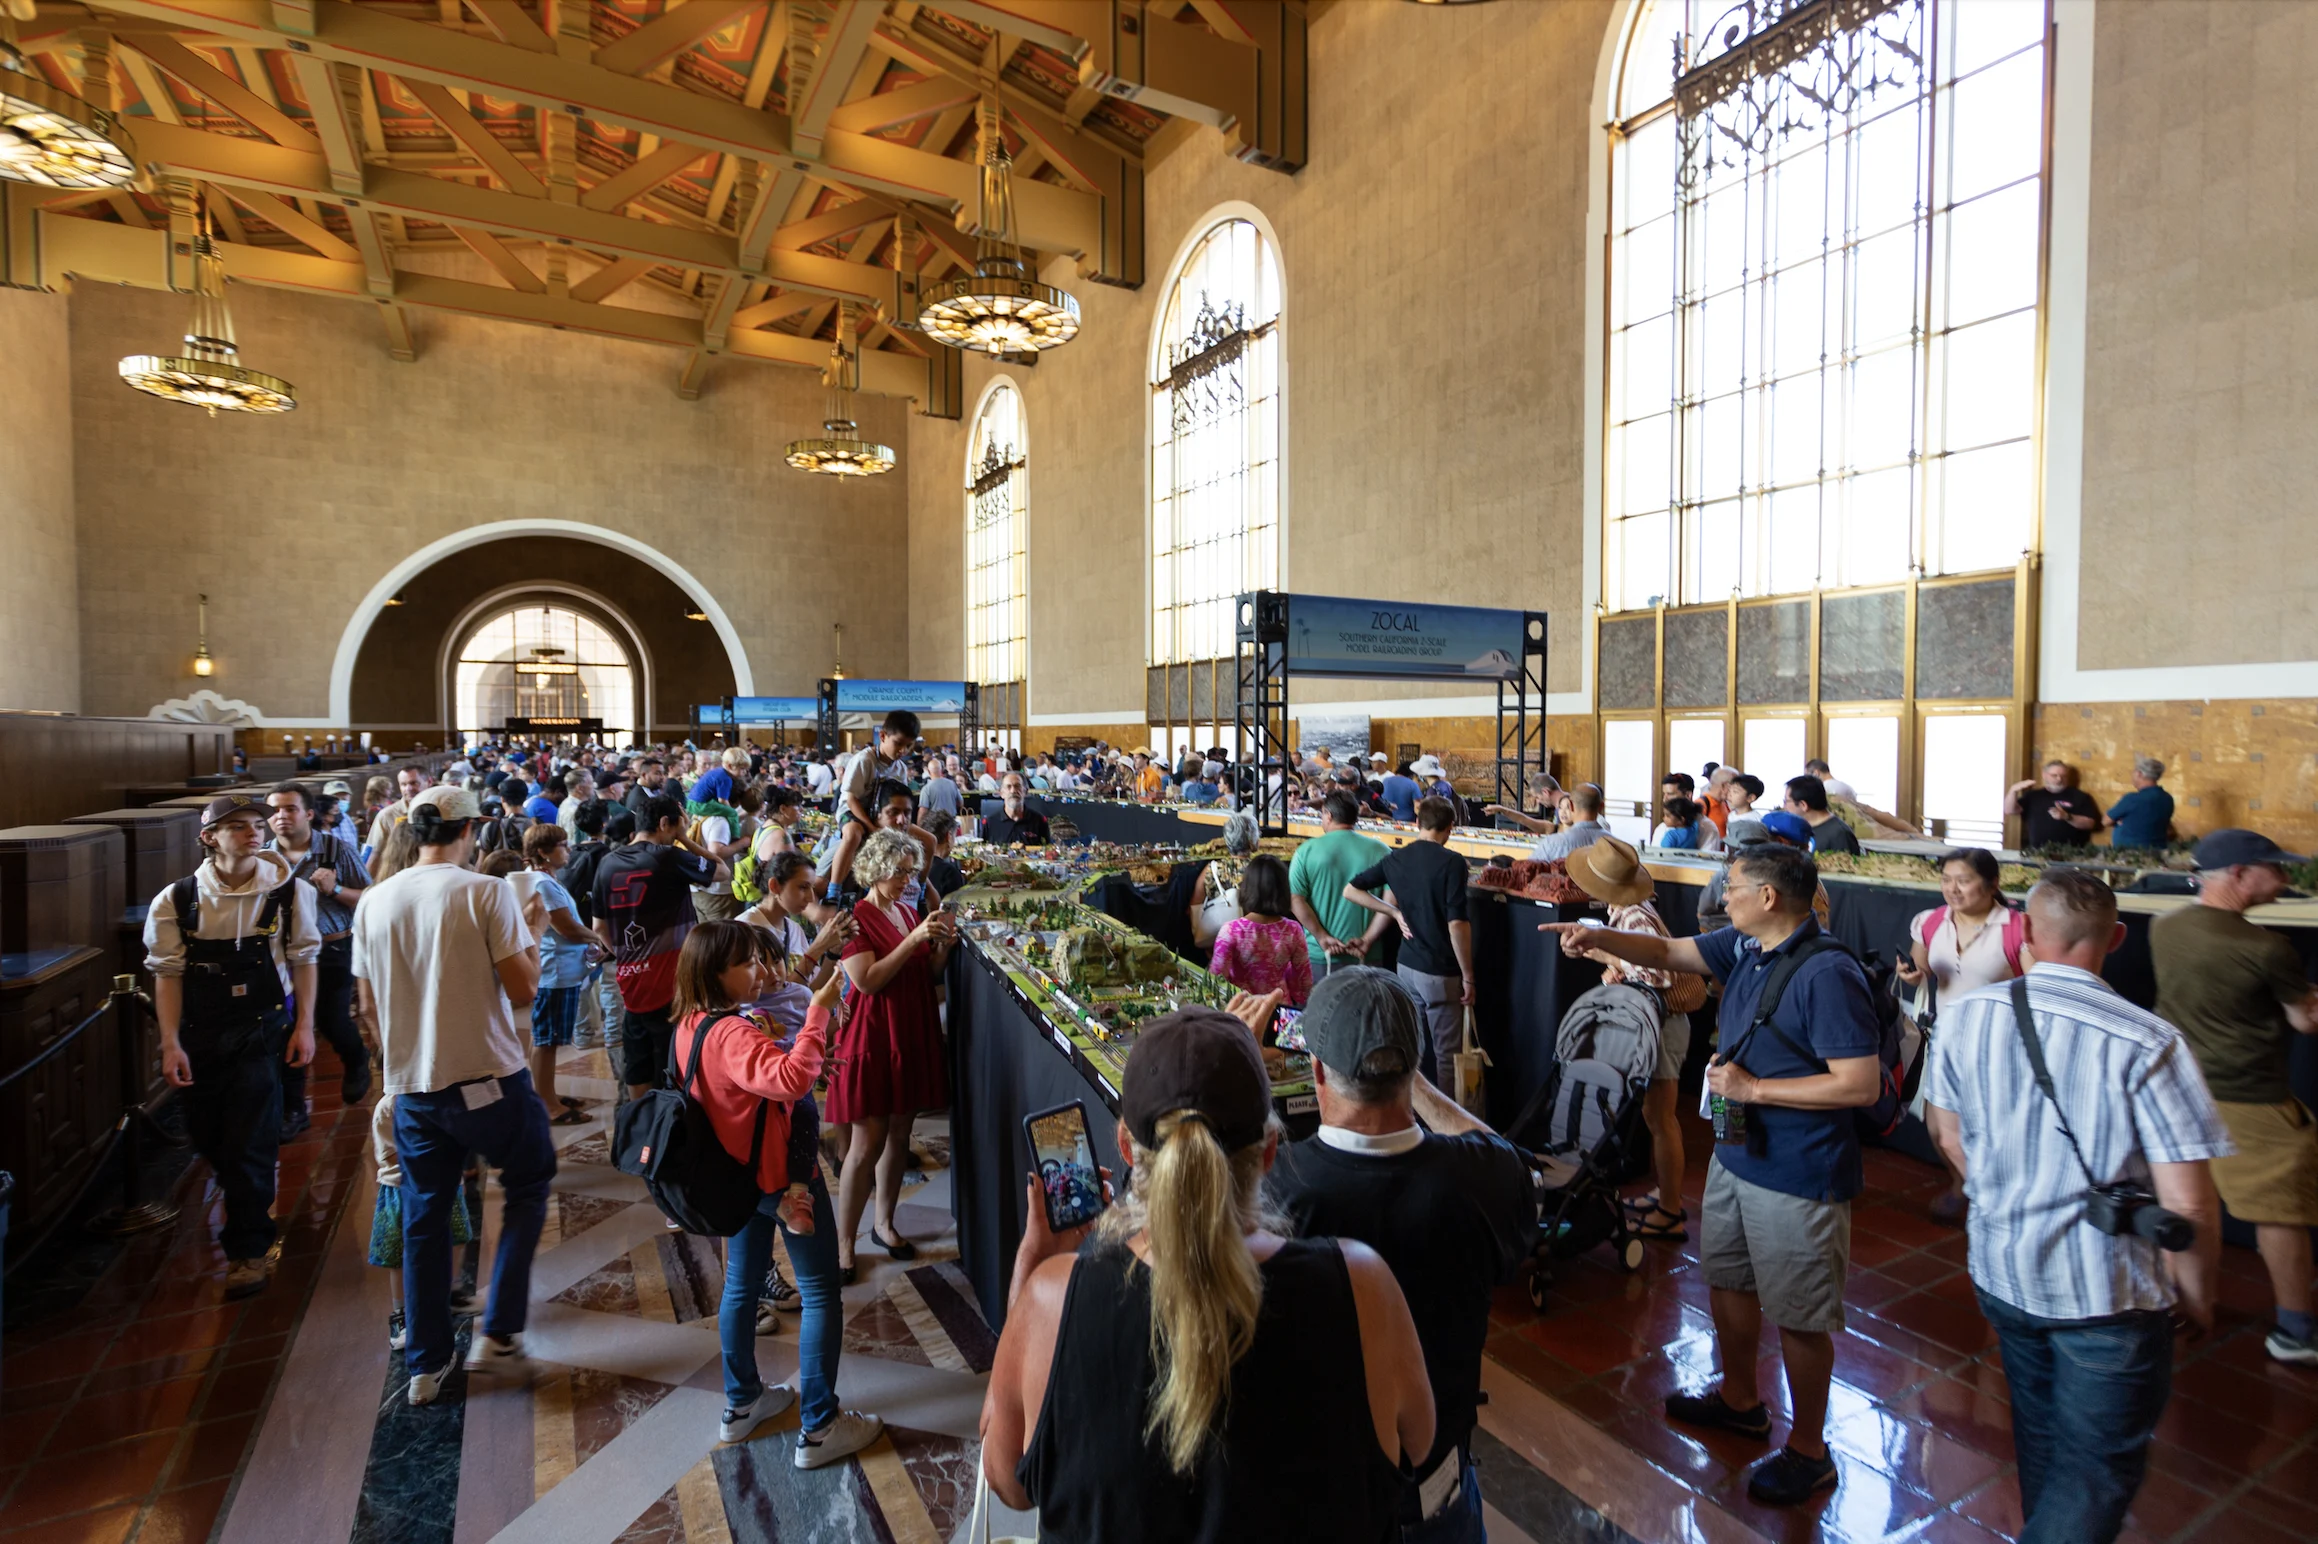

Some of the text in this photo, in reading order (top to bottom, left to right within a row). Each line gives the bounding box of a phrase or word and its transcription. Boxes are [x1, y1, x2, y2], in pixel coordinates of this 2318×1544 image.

[1371, 611, 1421, 632] ZOCAL
[1339, 632, 1378, 643] SOUTHERN
[1379, 634, 1419, 645] CALIFORNIA
[1346, 643, 1443, 657] MODEL RAILROADING GROUP
[867, 686, 922, 695] ORANGE COUNTY
